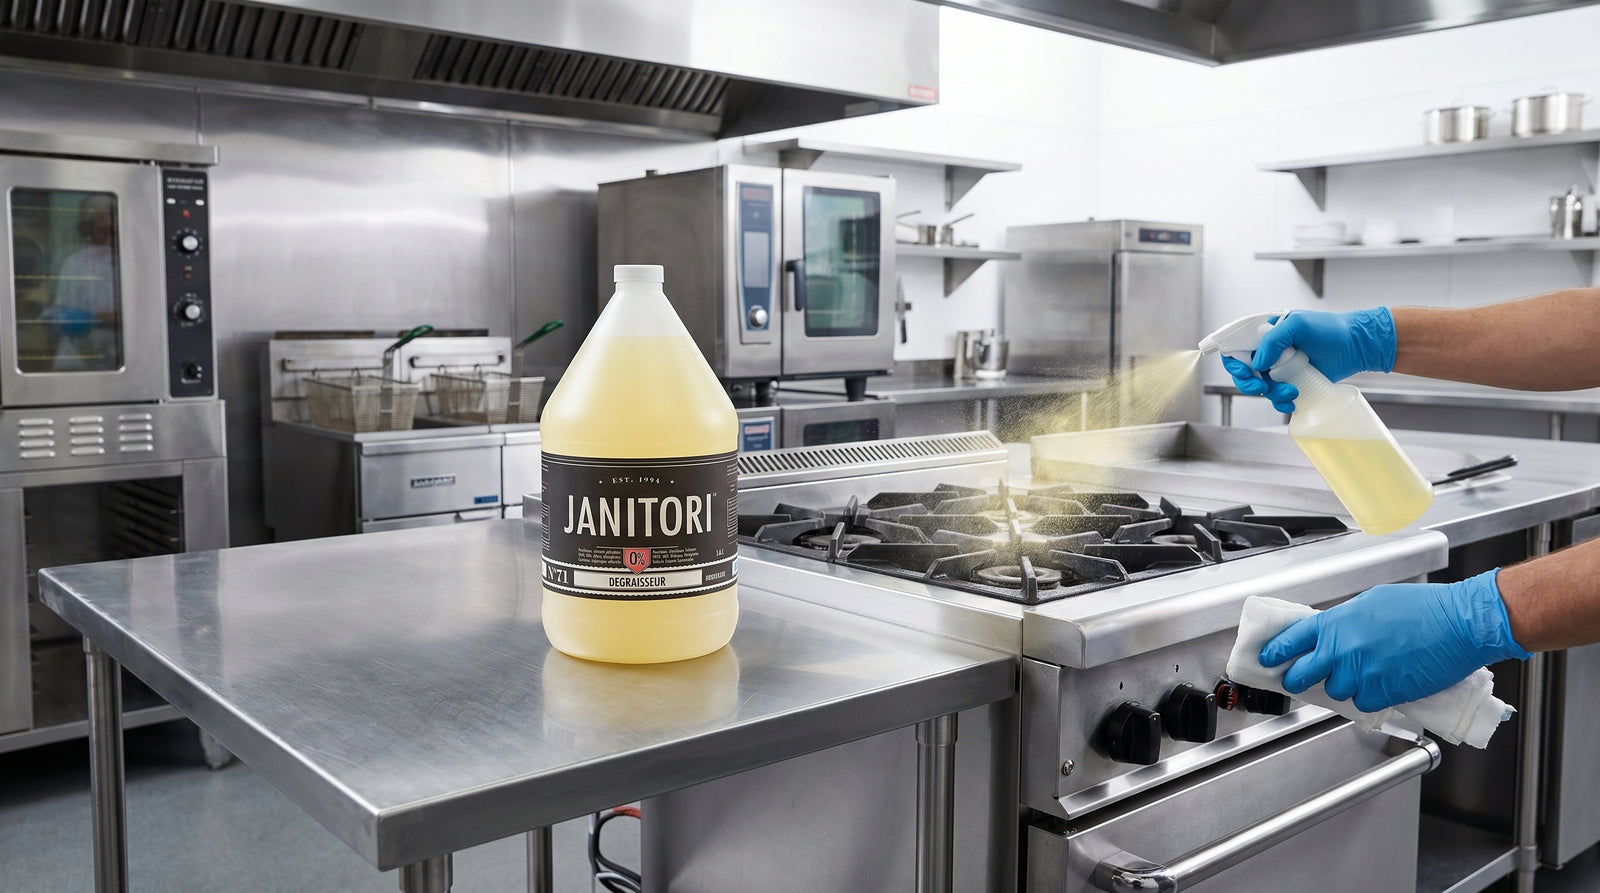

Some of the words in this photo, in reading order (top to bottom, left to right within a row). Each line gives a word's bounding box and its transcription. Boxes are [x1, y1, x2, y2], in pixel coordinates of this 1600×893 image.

[563, 493, 712, 537] JANITORI
[629, 551, 645, 566] 0%
[609, 576, 666, 587] DEGRAISSEUR
